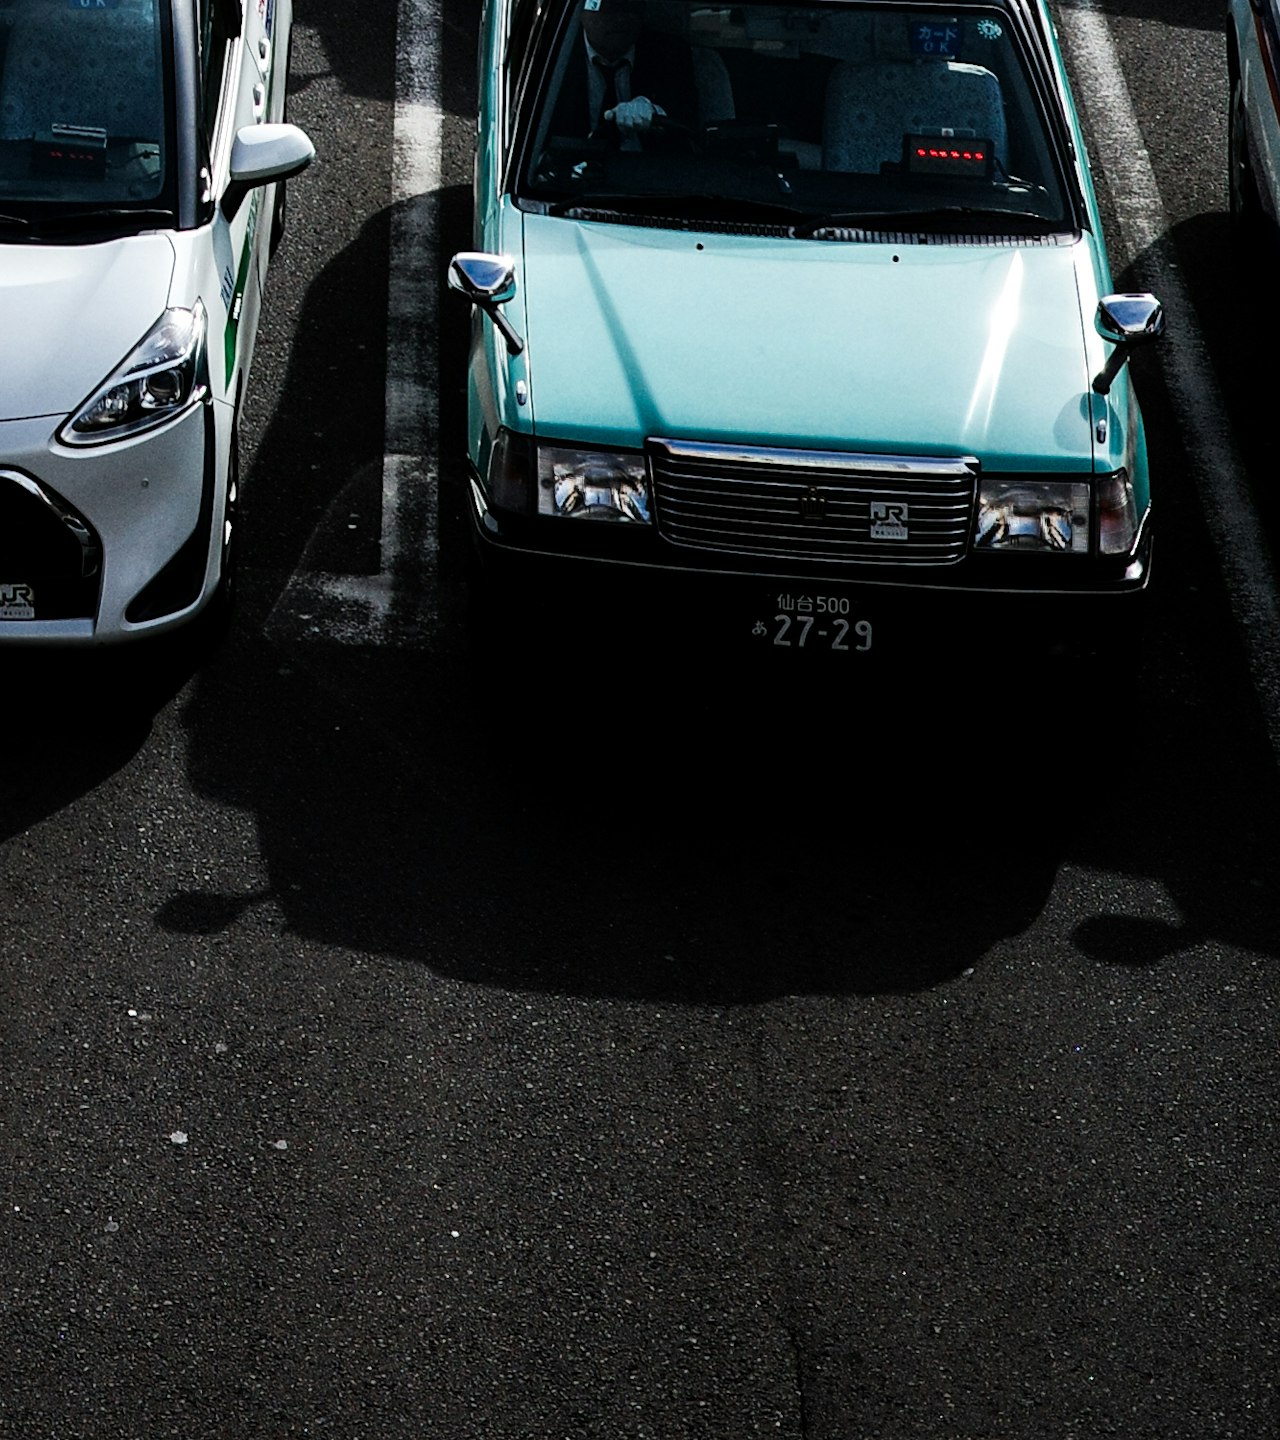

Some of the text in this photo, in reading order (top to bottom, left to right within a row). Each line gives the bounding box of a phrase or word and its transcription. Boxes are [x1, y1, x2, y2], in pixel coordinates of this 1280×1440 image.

[919, 25, 958, 41] カード
[923, 40, 949, 53] OK
[873, 505, 905, 521] JR
[776, 592, 851, 616] 仙台500
[751, 613, 874, 653] あ 27-29
